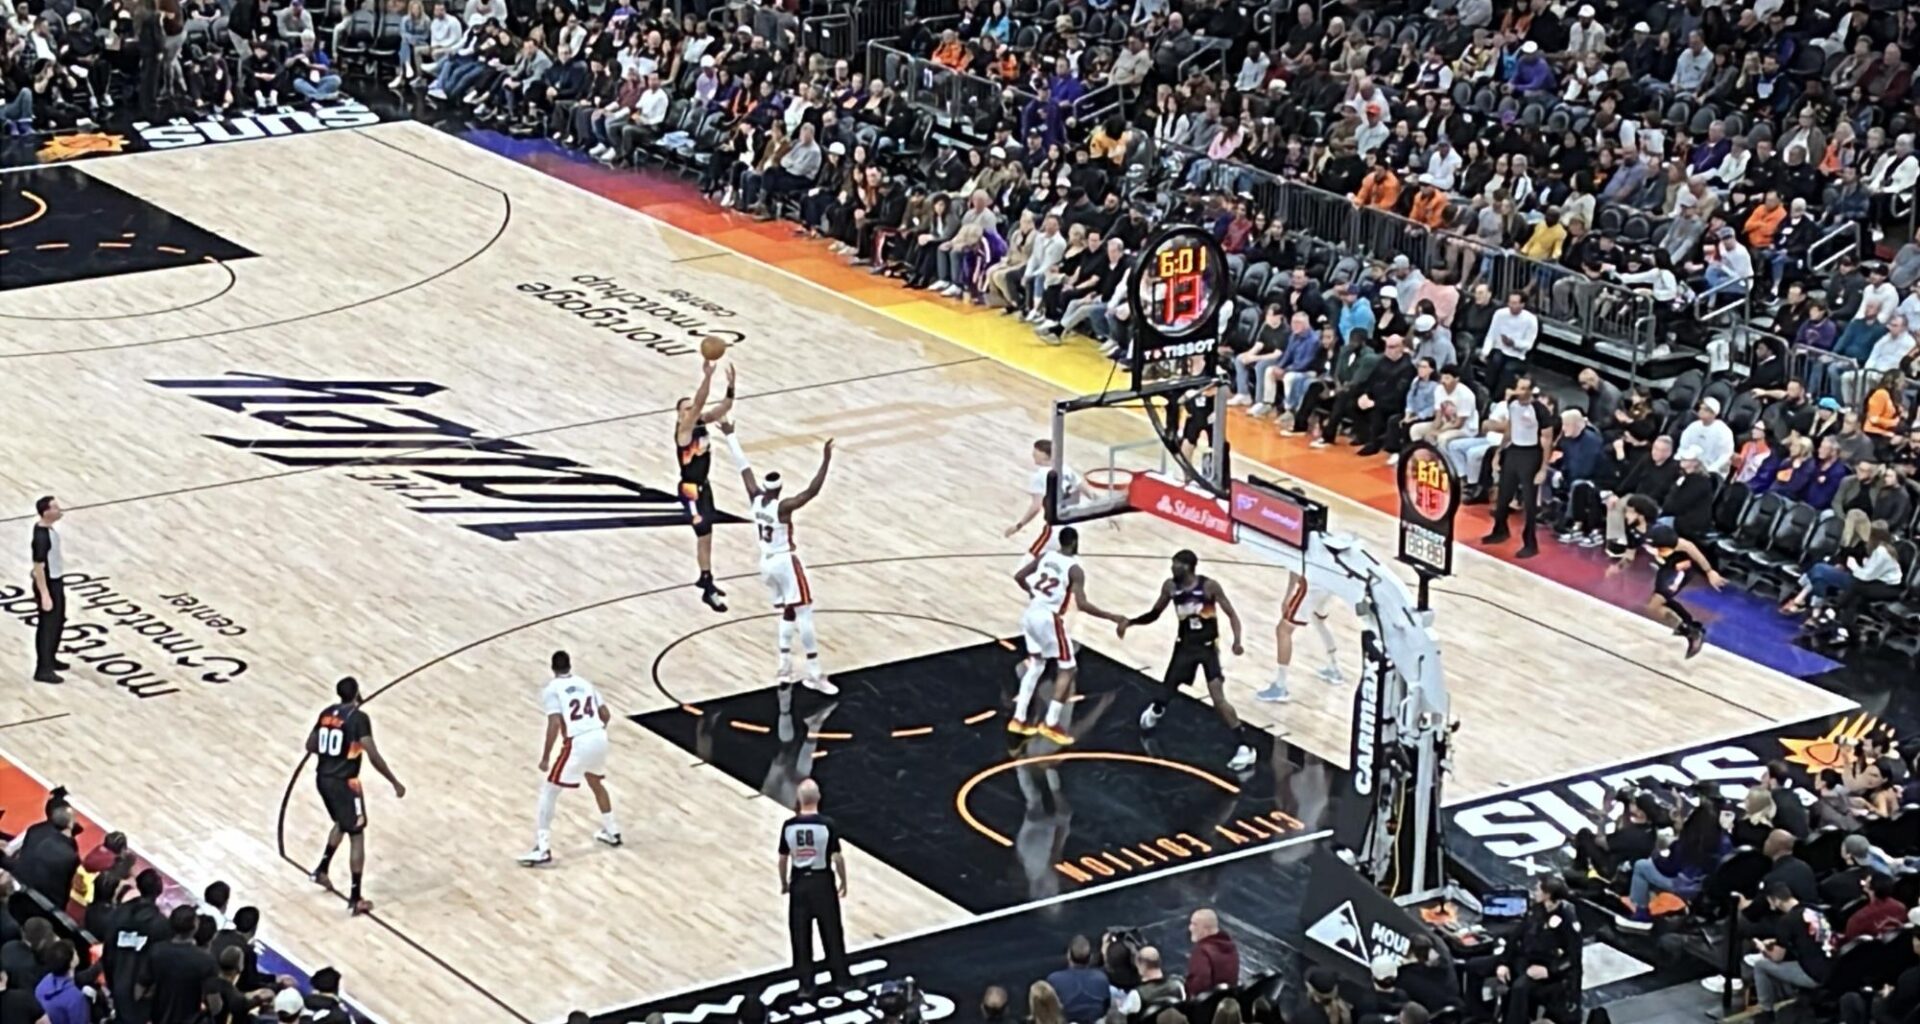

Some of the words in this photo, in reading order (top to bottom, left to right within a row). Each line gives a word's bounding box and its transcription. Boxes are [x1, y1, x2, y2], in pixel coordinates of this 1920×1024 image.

[1160, 245, 1206, 277] 6:01
[572, 274, 706, 329] matchup
[658, 288, 736, 317] center
[1165, 274, 1202, 324] 13
[516, 282, 696, 356] mortgage
[1163, 338, 1215, 358] TISSOT
[346, 472, 460, 500] THE
[757, 522, 774, 543] 13
[1034, 572, 1060, 598] 22
[61, 572, 204, 654] matchup
[159, 592, 247, 637] center
[569, 696, 595, 721] 24
[318, 726, 343, 756] 00
[1215, 810, 1305, 845] CITY
[1054, 832, 1212, 883] EDITION
